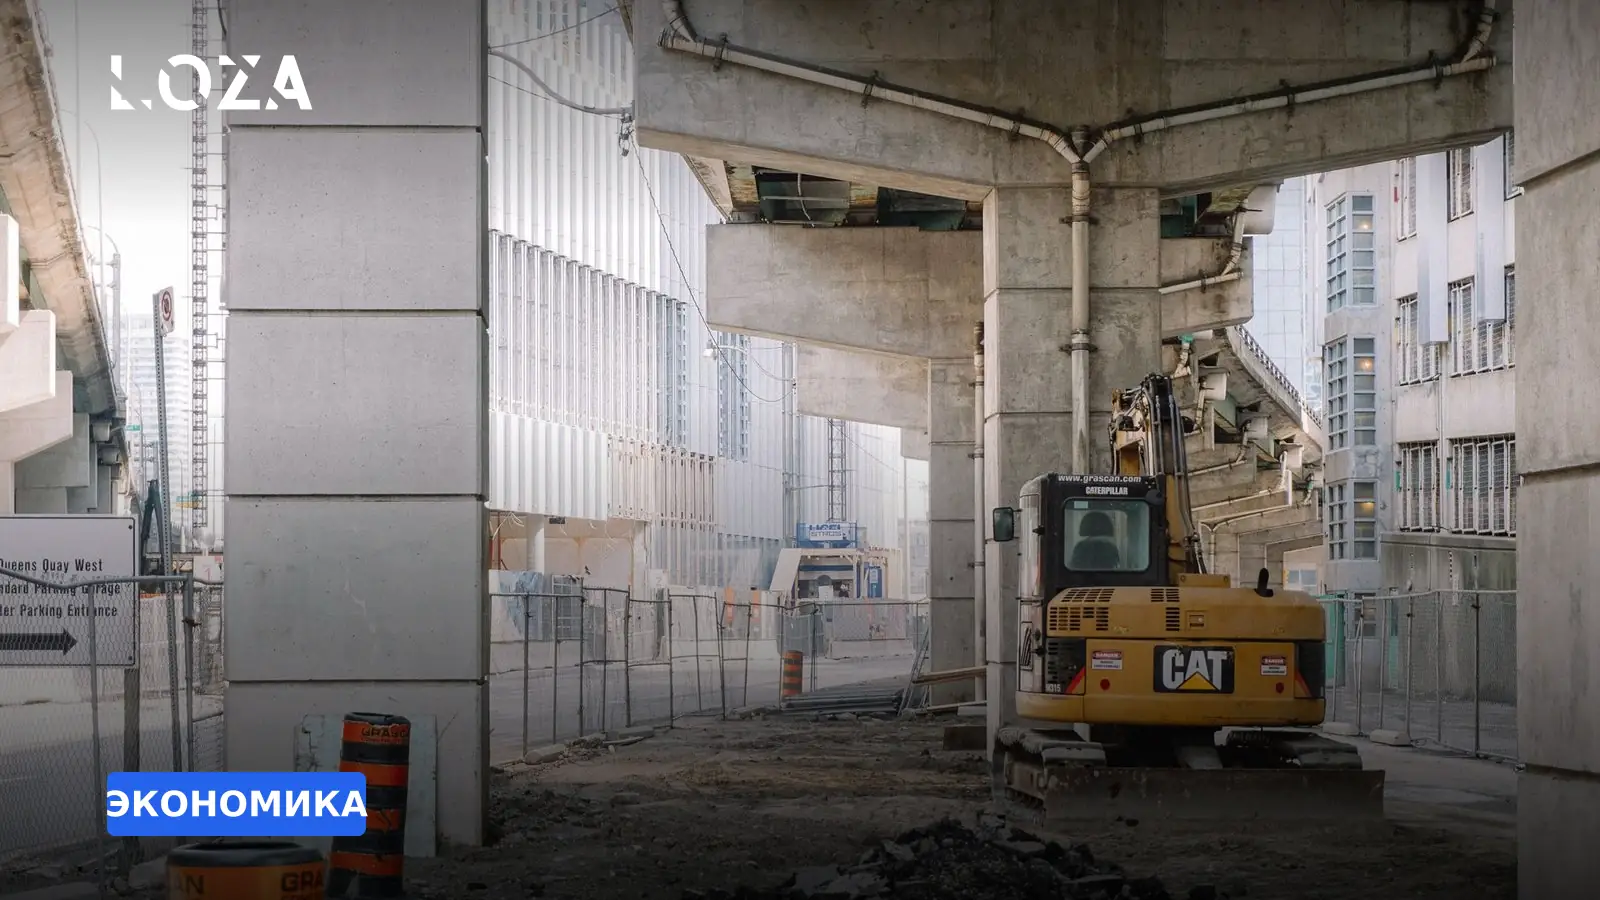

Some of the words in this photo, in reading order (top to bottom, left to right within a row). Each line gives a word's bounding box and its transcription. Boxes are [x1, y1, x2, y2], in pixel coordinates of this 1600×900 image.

[1058, 475, 1142, 484] www.grascan.com
[1085, 486, 1129, 495] CATERPILLAR
[42, 558, 69, 573] Quay
[74, 558, 103, 572] West
[81, 582, 121, 597] Grage
[20, 603, 62, 619] Parking
[1162, 649, 1229, 691] CAT
